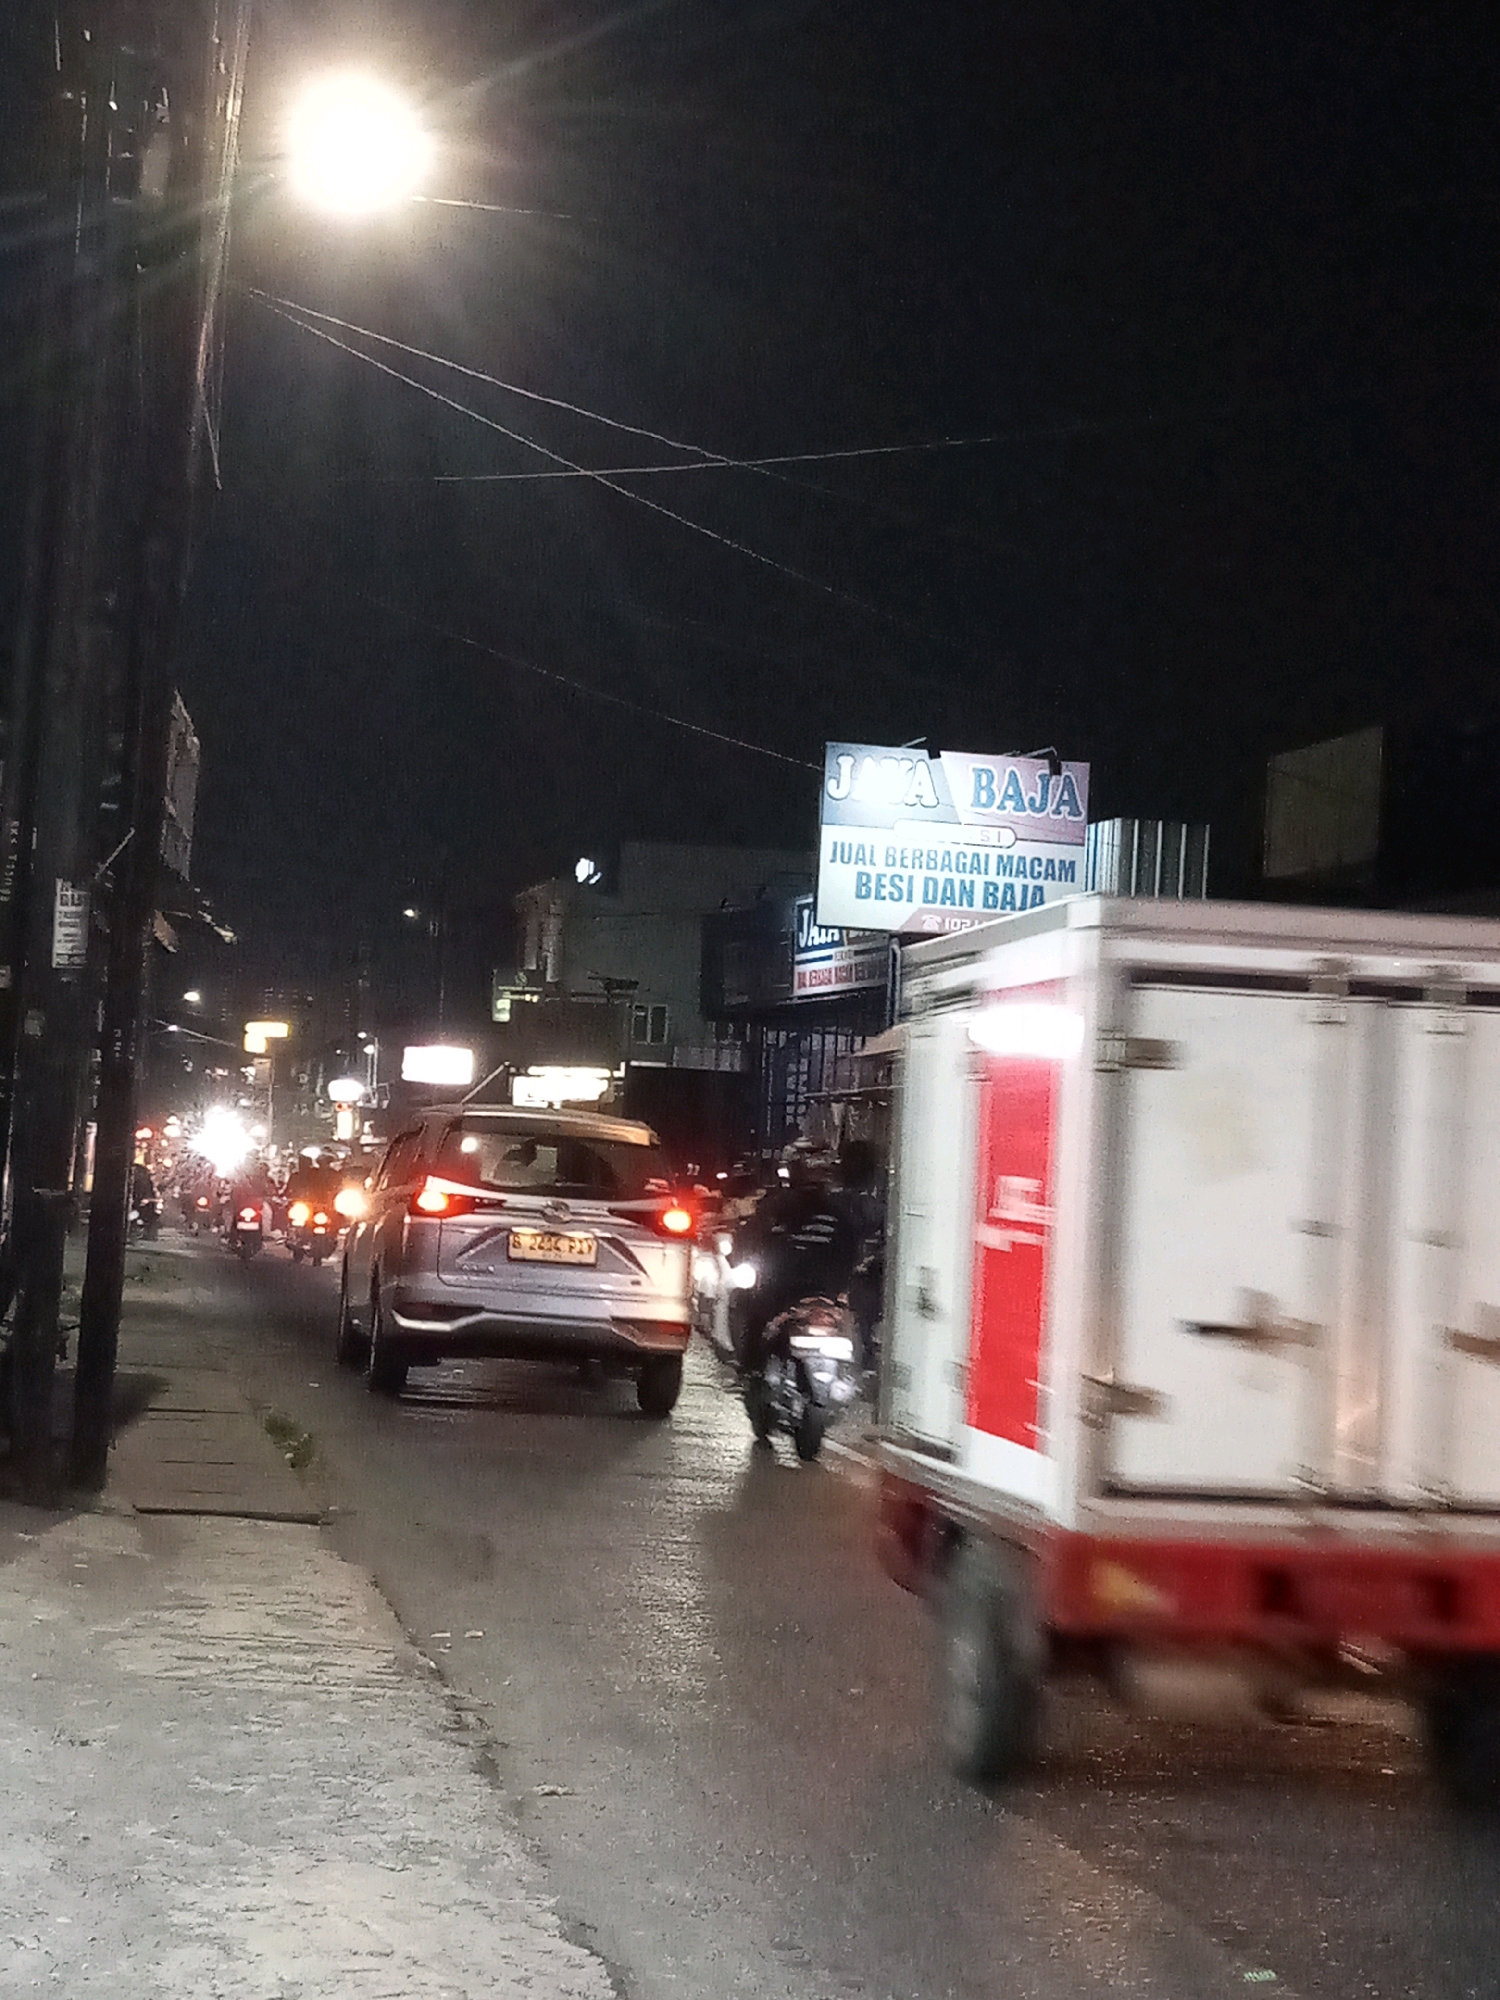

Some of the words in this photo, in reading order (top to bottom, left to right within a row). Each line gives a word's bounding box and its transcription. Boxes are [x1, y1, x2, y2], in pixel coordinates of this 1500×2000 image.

[970, 766, 1083, 818] BAJA
[829, 841, 876, 866] JUAL
[885, 846, 989, 873] BERBAGAI
[996, 855, 1076, 883] MACAM
[855, 871, 914, 903] BESI
[922, 876, 975, 908] DAN
[981, 881, 1045, 912] BAJA
